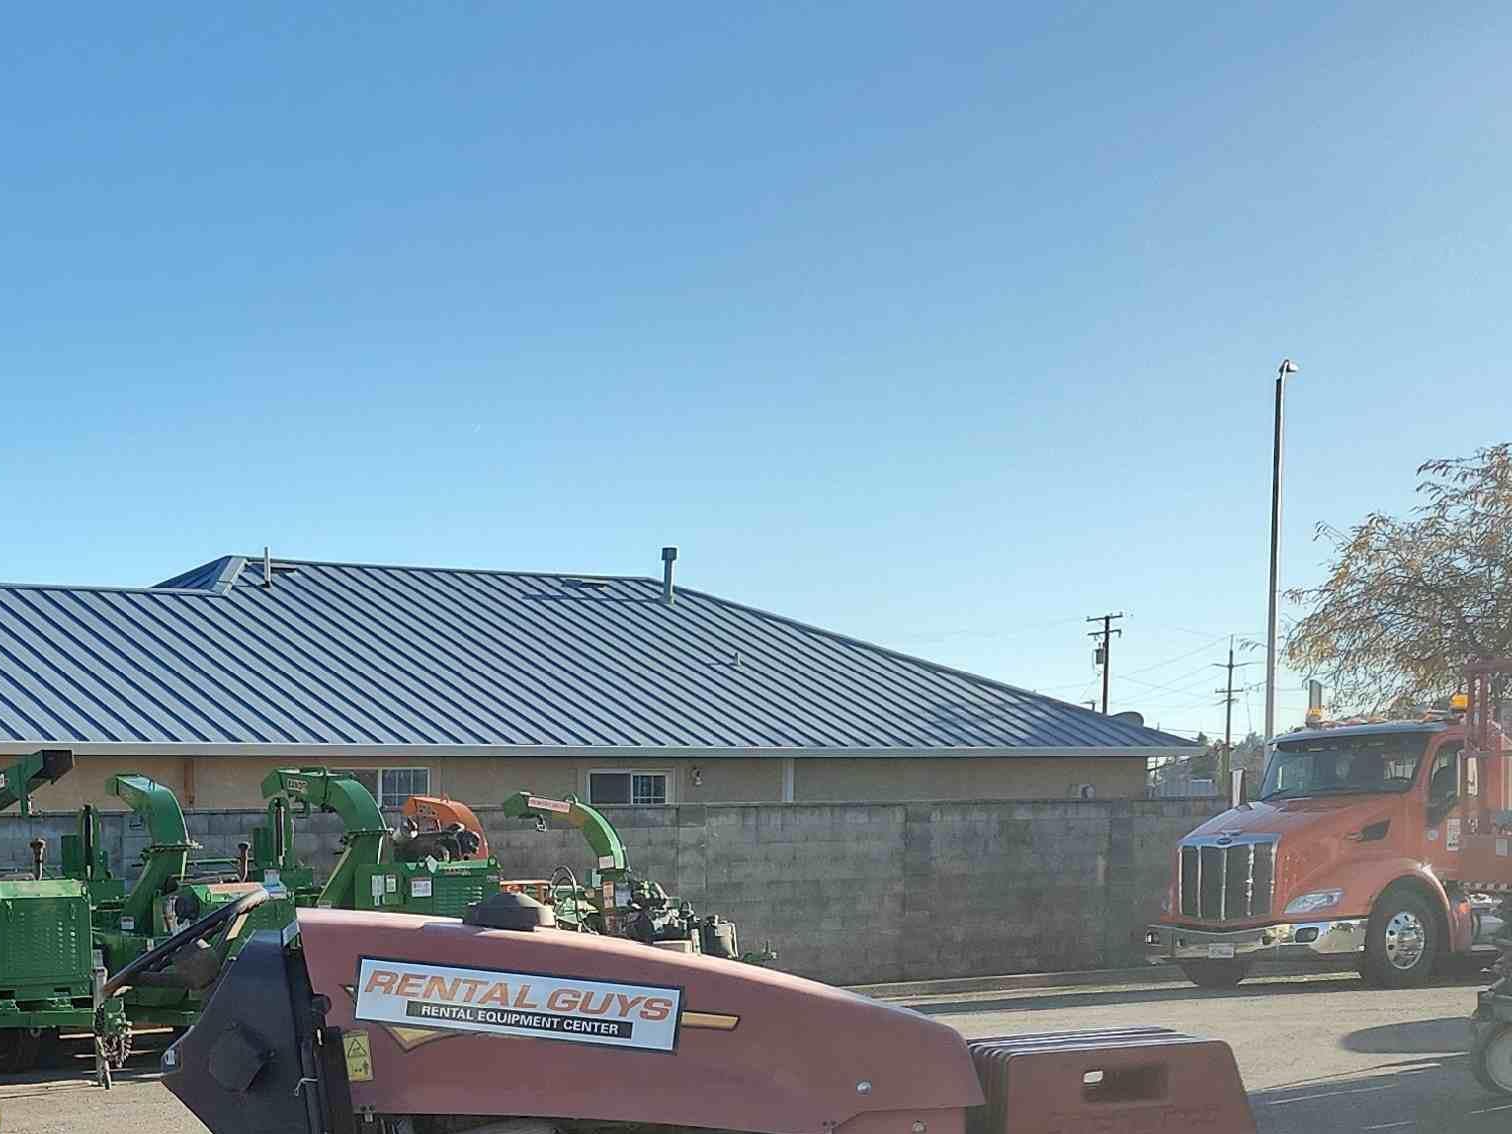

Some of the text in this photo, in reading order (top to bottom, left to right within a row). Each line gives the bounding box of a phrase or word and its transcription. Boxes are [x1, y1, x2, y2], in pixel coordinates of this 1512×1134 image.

[364, 969, 674, 1022] RENTAL GUYS
[421, 1004, 619, 1036] RENTAL EQUIPMENT CENTER
